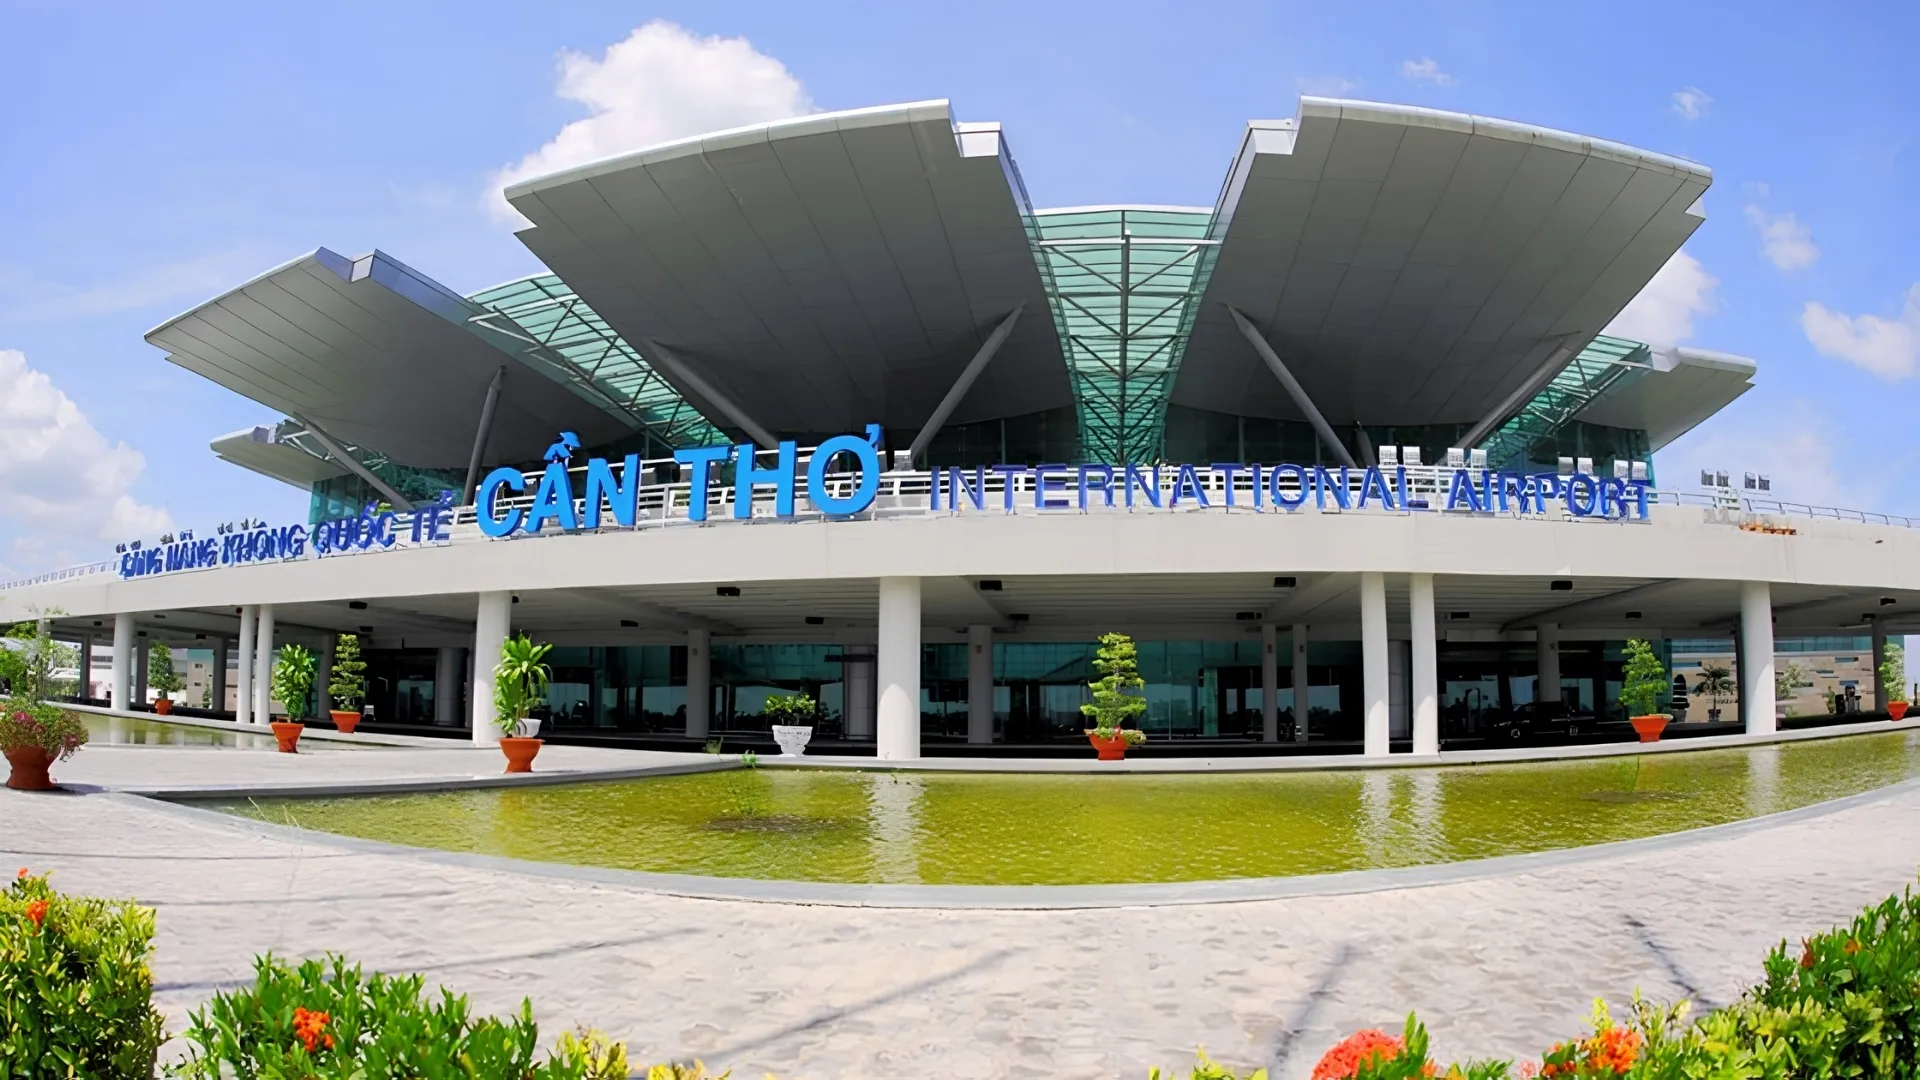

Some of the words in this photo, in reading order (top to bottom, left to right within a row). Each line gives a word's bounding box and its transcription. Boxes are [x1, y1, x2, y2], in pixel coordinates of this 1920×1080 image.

[674, 423, 884, 521] THƠ
[930, 463, 1430, 513] INTERNATIONAL
[1447, 467, 1654, 521] AIRPORT
